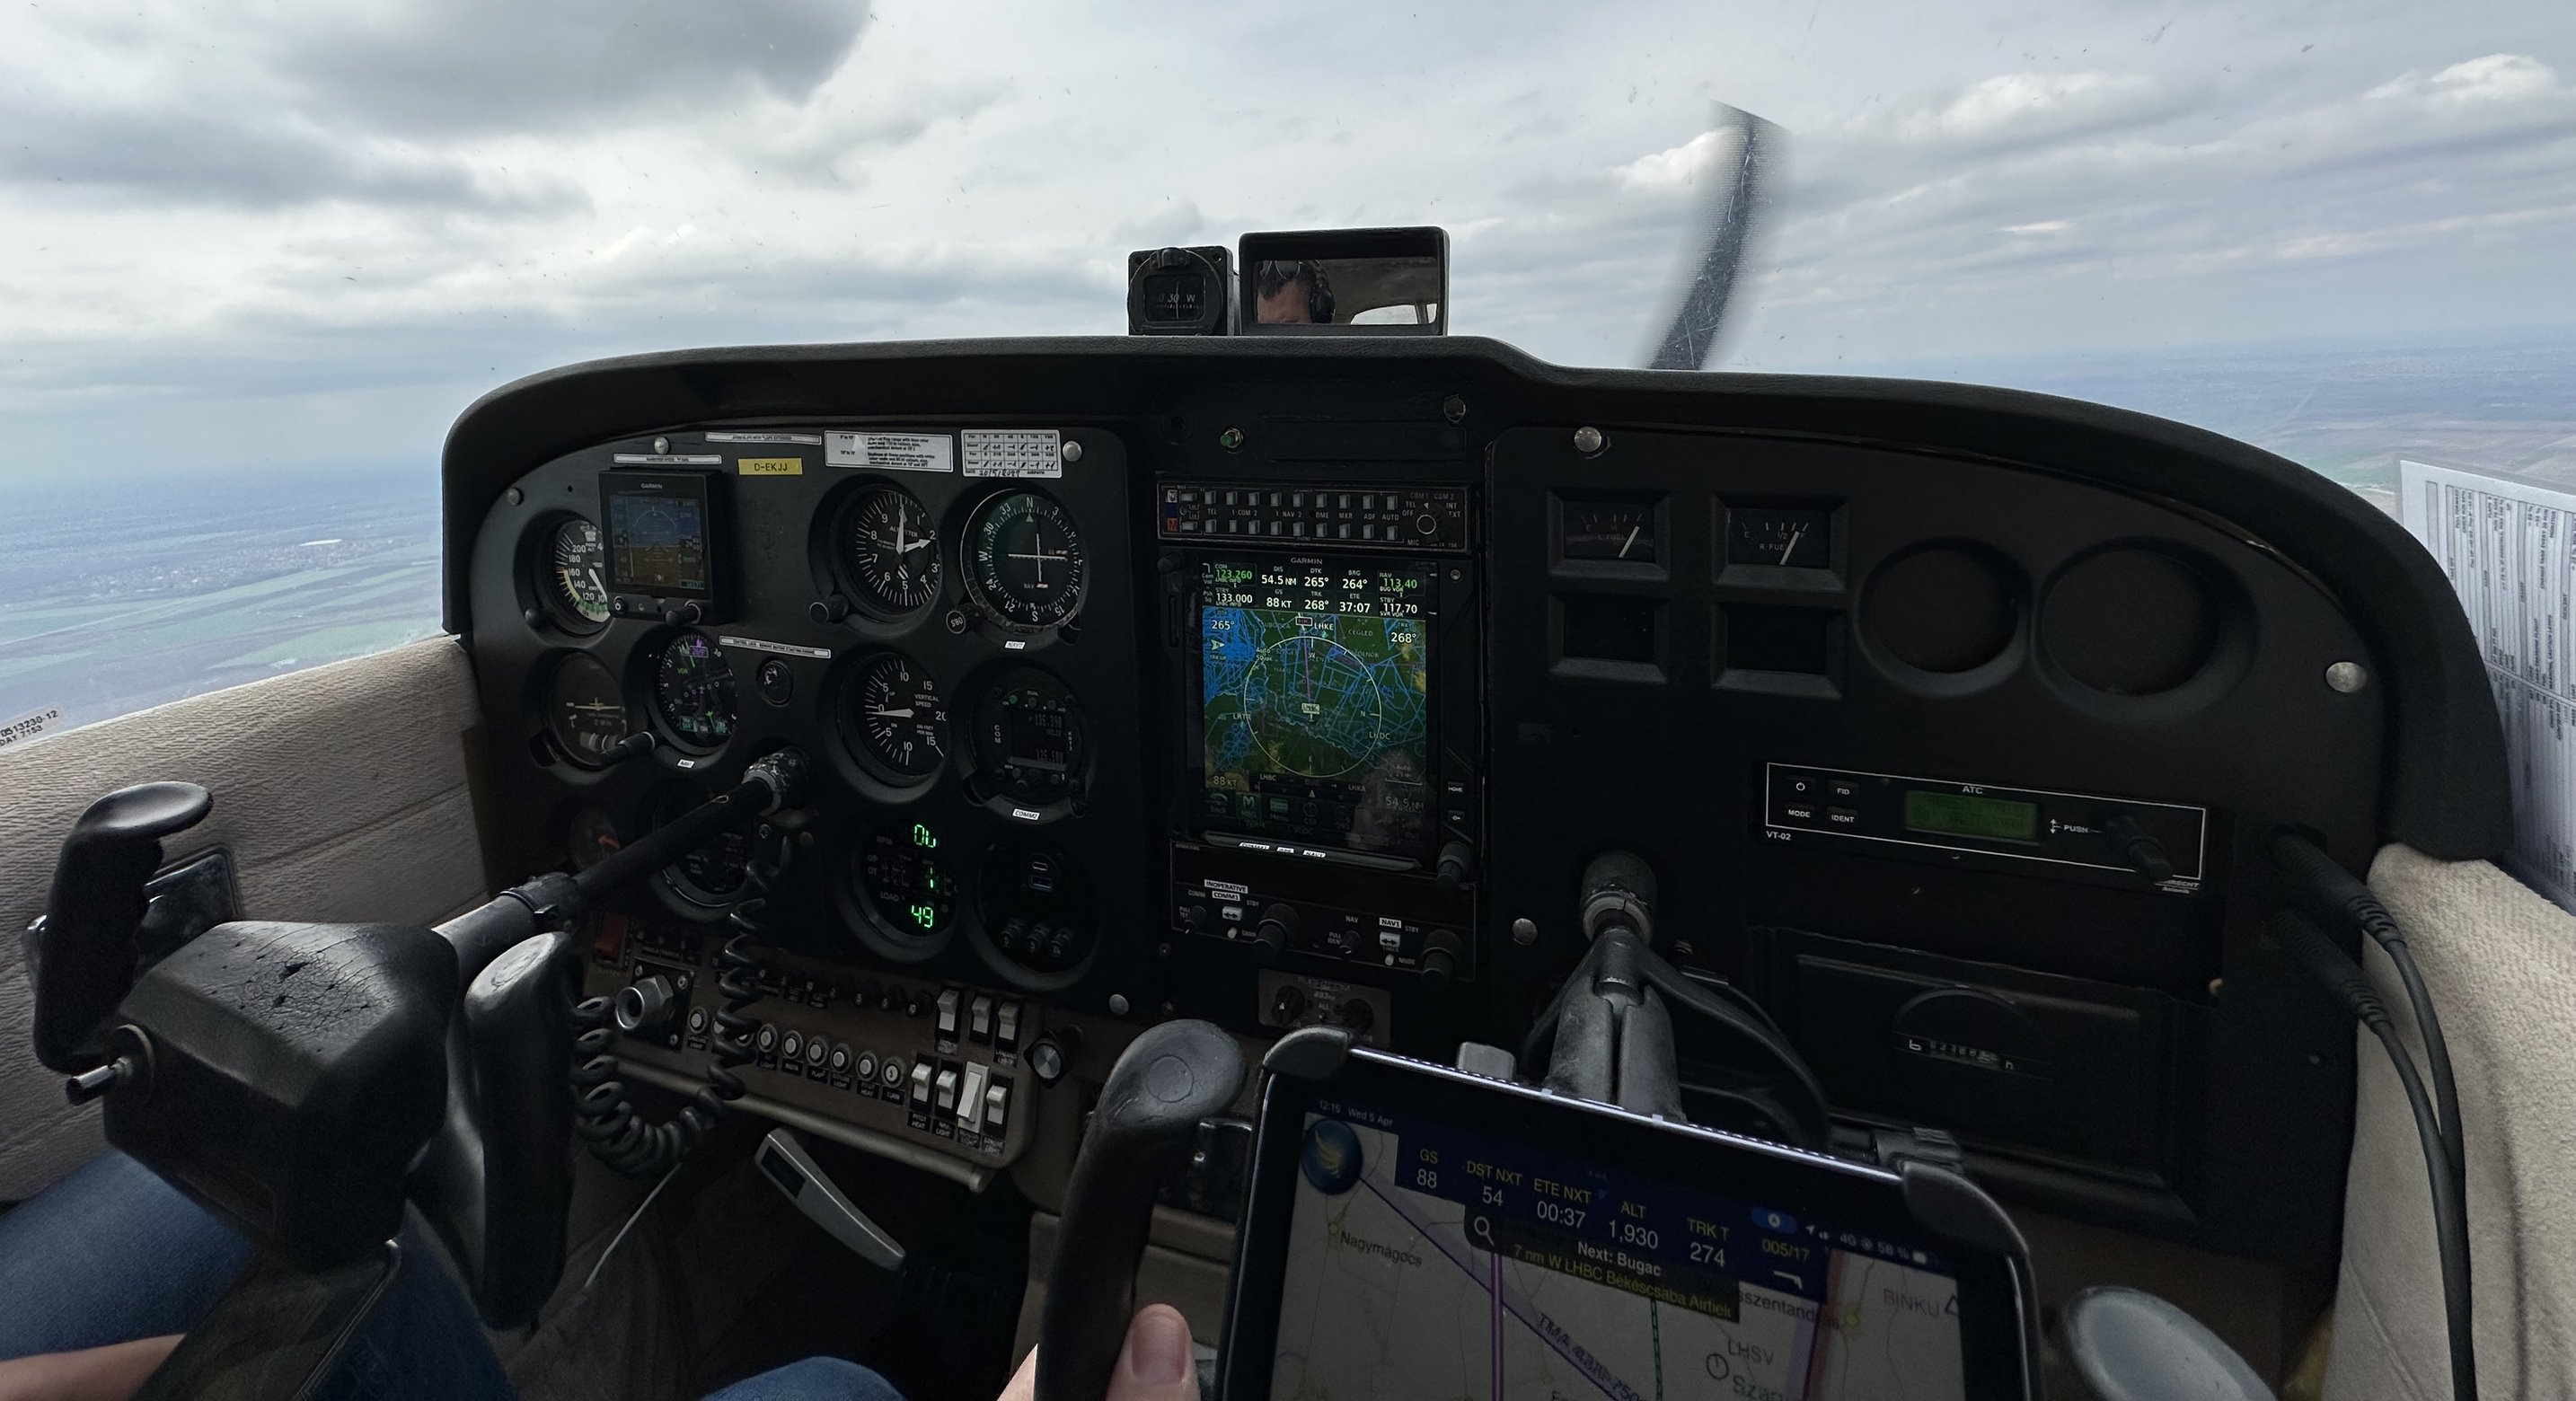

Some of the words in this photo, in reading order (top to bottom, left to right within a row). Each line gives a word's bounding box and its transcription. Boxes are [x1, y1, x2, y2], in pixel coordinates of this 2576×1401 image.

[754, 463, 788, 471] D-EKJJ
[1026, 497, 1033, 508] N
[1000, 503, 1011, 515] 33
[1053, 507, 1060, 516] 3
[1402, 509, 1415, 517] OFF
[881, 514, 888, 523] 9
[1381, 514, 1399, 522] AUTO
[984, 522, 994, 535] 30
[870, 530, 878, 541] 8
[930, 530, 936, 540] 2
[571, 544, 587, 553] 200
[1407, 539, 1420, 547] MIC
[569, 555, 581, 563] 180
[871, 553, 878, 564] 7
[977, 551, 988, 562] W
[1291, 557, 1323, 565] GARMIN
[569, 568, 580, 577] 160
[931, 563, 938, 573] 3
[884, 571, 891, 582] 6
[1216, 569, 1252, 579] 123.260
[573, 580, 587, 589] 140
[902, 580, 909, 590] 5
[920, 575, 927, 585] 4
[1261, 575, 1284, 585] 54.5
[1284, 577, 1297, 586] NM
[1304, 577, 1329, 587] 265°
[1342, 578, 1367, 589] 264°
[1383, 578, 1417, 588] 113.40
[582, 592, 595, 601] 120
[1216, 593, 1253, 604] 133.000
[1266, 598, 1279, 608] 88
[1280, 600, 1292, 608] KT
[1304, 600, 1329, 611] 268°
[1339, 602, 1371, 613] 37:07
[1383, 604, 1417, 614] 117.70
[1032, 611, 1038, 622] S
[1212, 620, 1235, 630] 265°
[1390, 632, 1416, 643] 268°
[900, 672, 909, 683] 10
[883, 683, 889, 692] 5
[923, 680, 933, 691] 15
[914, 693, 940, 702] VERTICAL
[878, 704, 885, 712] 0
[915, 700, 932, 709] SPEED
[0, 709, 57, 736] 0513230-12
[886, 727, 892, 736] 5
[993, 724, 1001, 744] COM
[904, 741, 913, 751] 10
[927, 736, 936, 746] 15
[1213, 776, 1226, 786] 88
[1836, 788, 1850, 796] FID
[1962, 785, 1983, 796] ATC
[1015, 810, 1038, 819] COMM2
[1787, 808, 1811, 819] MODE
[1831, 814, 1856, 824] IDENT
[2063, 824, 2089, 834] PUSH
[1766, 831, 1792, 841] VT-02
[1206, 882, 1247, 893] INOPERATIVE
[911, 904, 934, 929] 49
[1345, 915, 1358, 923] NAV
[1319, 1099, 1342, 1115] 12:15
[1347, 1106, 1367, 1121] Wed
[1369, 1112, 1375, 1123] 5
[1378, 1114, 1394, 1126] Apr
[1419, 1149, 1438, 1164] GS
[1416, 1168, 1437, 1189] 88
[1467, 1160, 1493, 1177] DST
[1495, 1168, 1523, 1186] NXT
[1482, 1185, 1504, 1207] 54
[1534, 1178, 1561, 1196] ETE
[1563, 1185, 1592, 1205] NXT
[1536, 1200, 1586, 1229] 00:37
[1620, 1201, 1645, 1220] ALT
[1609, 1220, 1659, 1250] 1,930
[1687, 1218, 1719, 1239] TRK
[1721, 1227, 1730, 1243] T
[1340, 1230, 1424, 1268] Nagymágocs
[1762, 1238, 1811, 1263] 005/17
[1577, 1241, 1613, 1264] Next:
[1617, 1252, 1661, 1277] Bugac
[1689, 1242, 1726, 1268] 274
[1513, 1245, 1522, 1256] 7
[1525, 1250, 1545, 1264] nm
[1548, 1256, 1561, 1270] W
[1566, 1260, 1602, 1281] LHBC
[1606, 1270, 1686, 1305] Békéscsaba
[1883, 1290, 1940, 1317] BINKU
[1728, 1338, 1775, 1365] LHSV
